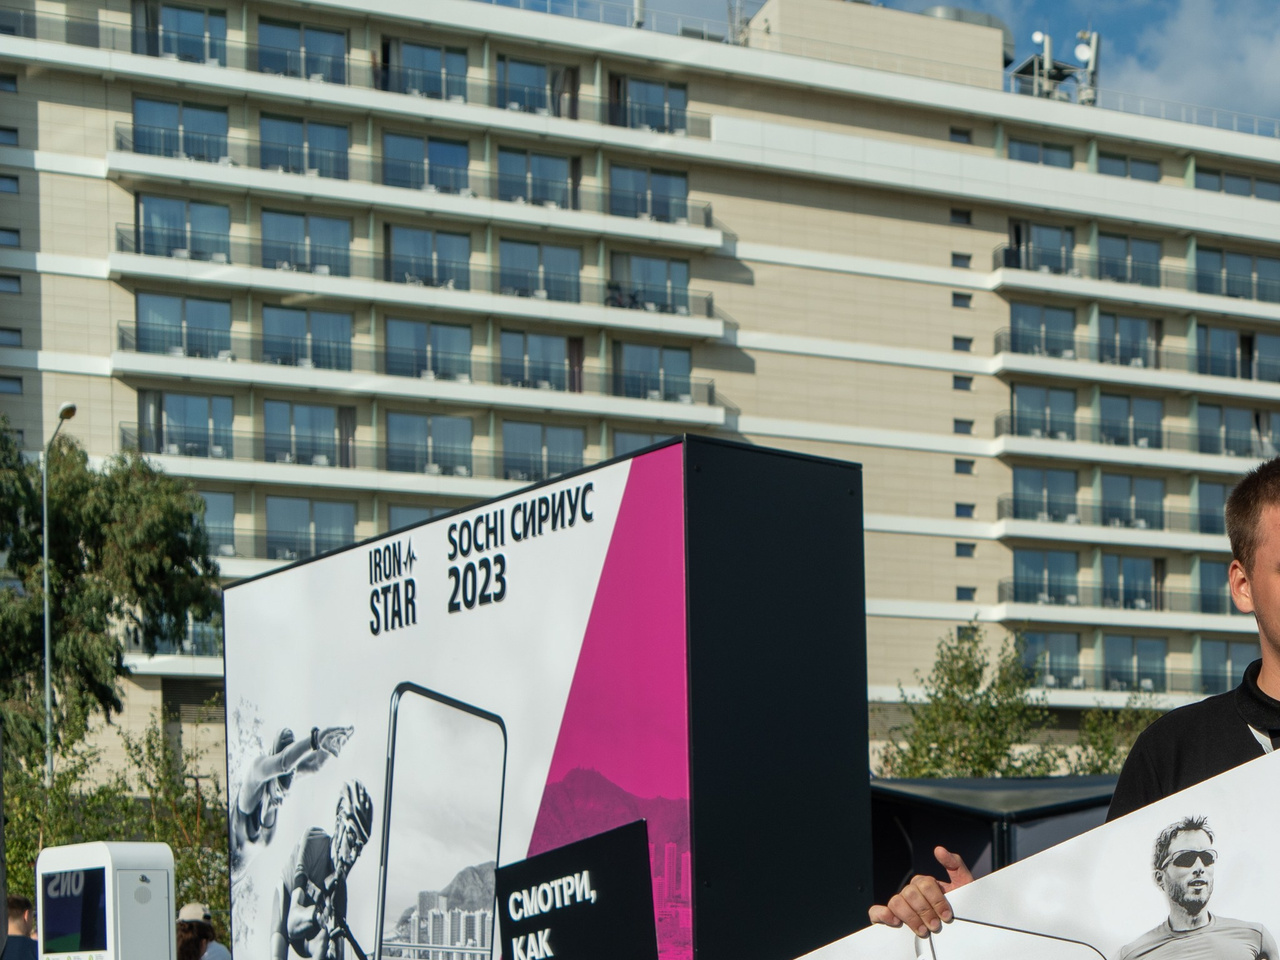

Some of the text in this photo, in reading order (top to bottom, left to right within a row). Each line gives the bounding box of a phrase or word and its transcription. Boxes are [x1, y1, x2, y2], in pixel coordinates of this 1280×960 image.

[448, 482, 595, 561] SOCHI СИРИУС
[369, 540, 402, 585] IRON
[448, 553, 507, 614] 2023
[370, 577, 417, 636] STAR
[508, 870, 597, 922] СМОТРИ,
